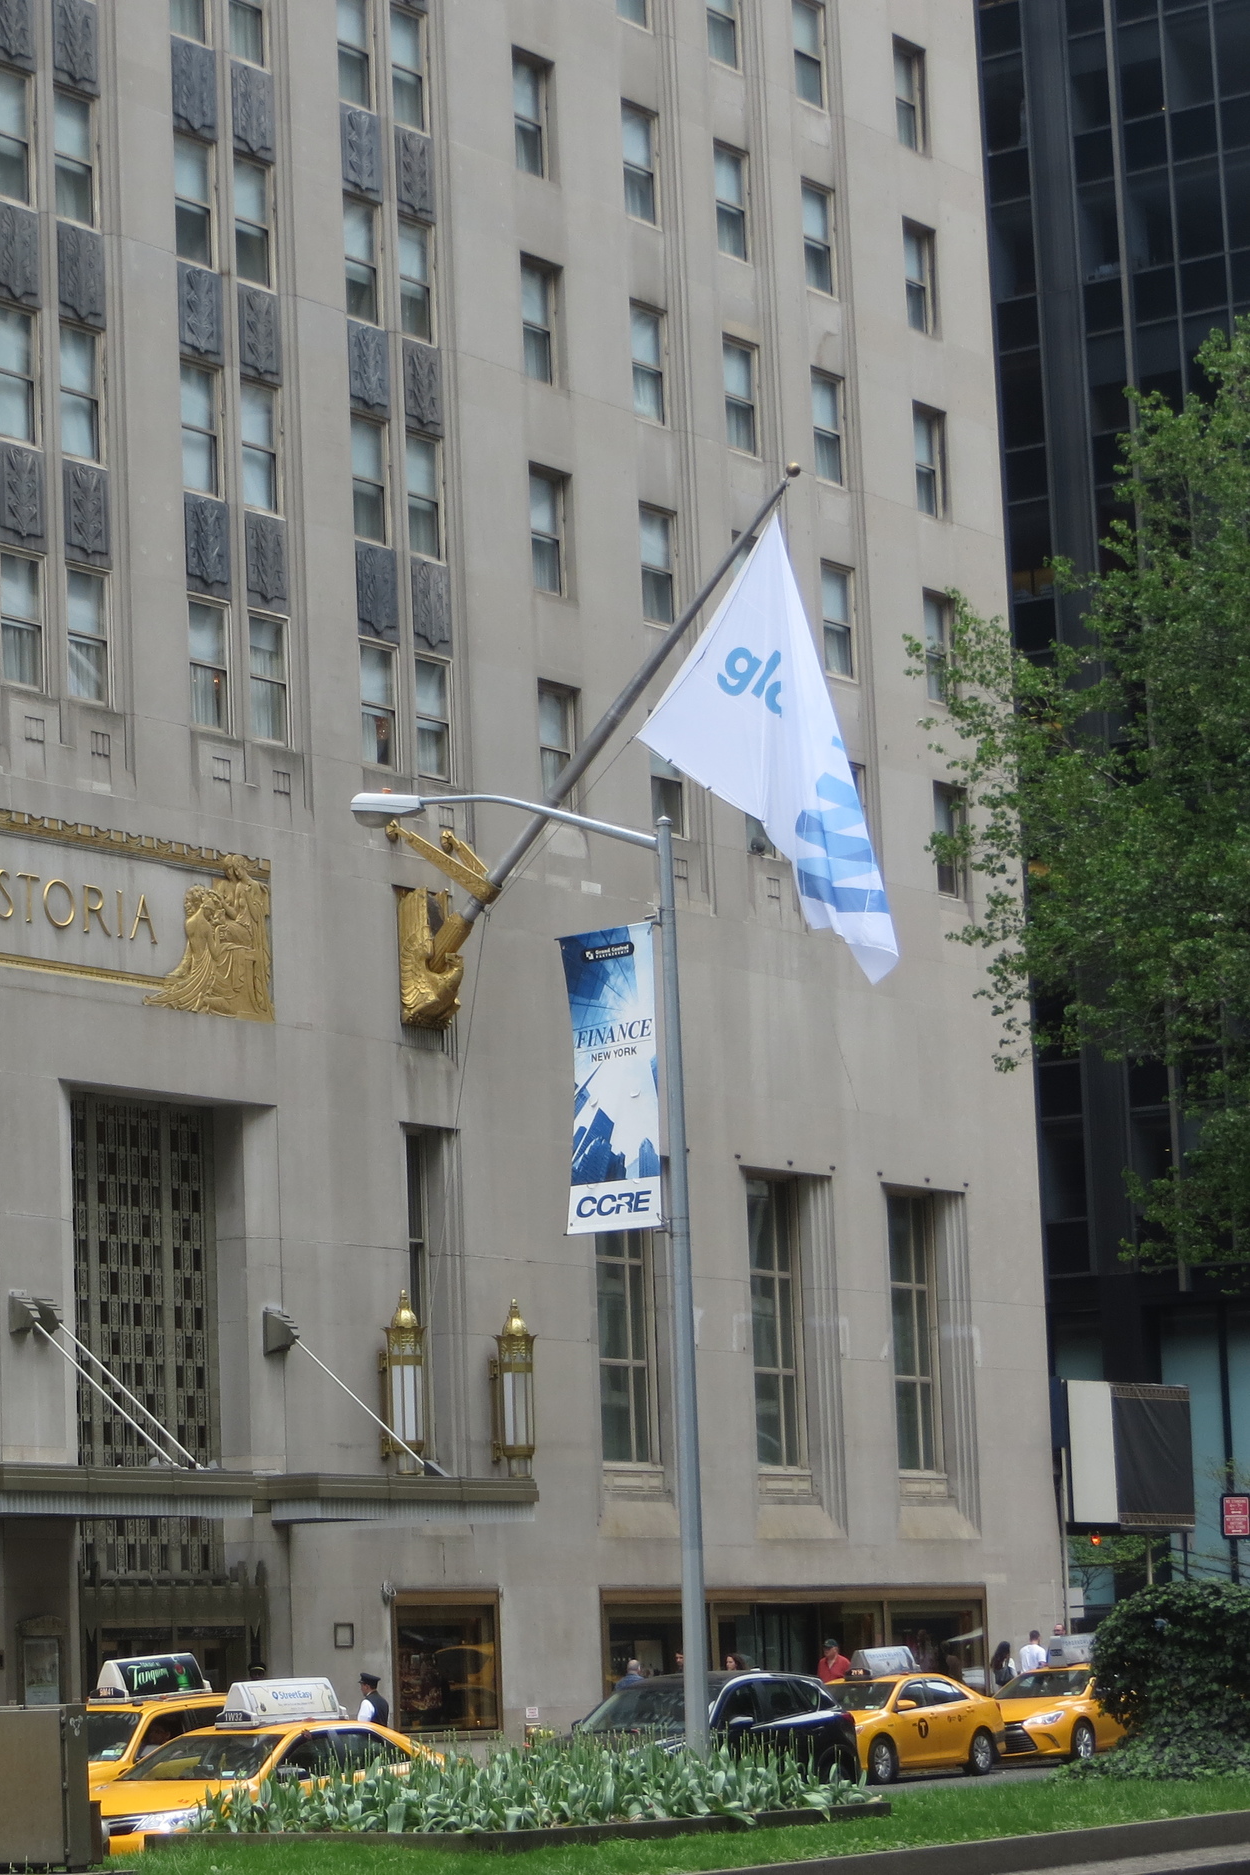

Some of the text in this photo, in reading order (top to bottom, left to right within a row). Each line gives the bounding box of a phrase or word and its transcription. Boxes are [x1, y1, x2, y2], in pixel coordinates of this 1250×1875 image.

[611, 944, 629, 952] Central
[576, 1018, 653, 1049] FINANCE
[591, 1046, 637, 1062] NEW YORK
[576, 1190, 652, 1218] CCRE
[278, 1691, 313, 1700] StreetEasy
[225, 1712, 243, 1722] 1W32
